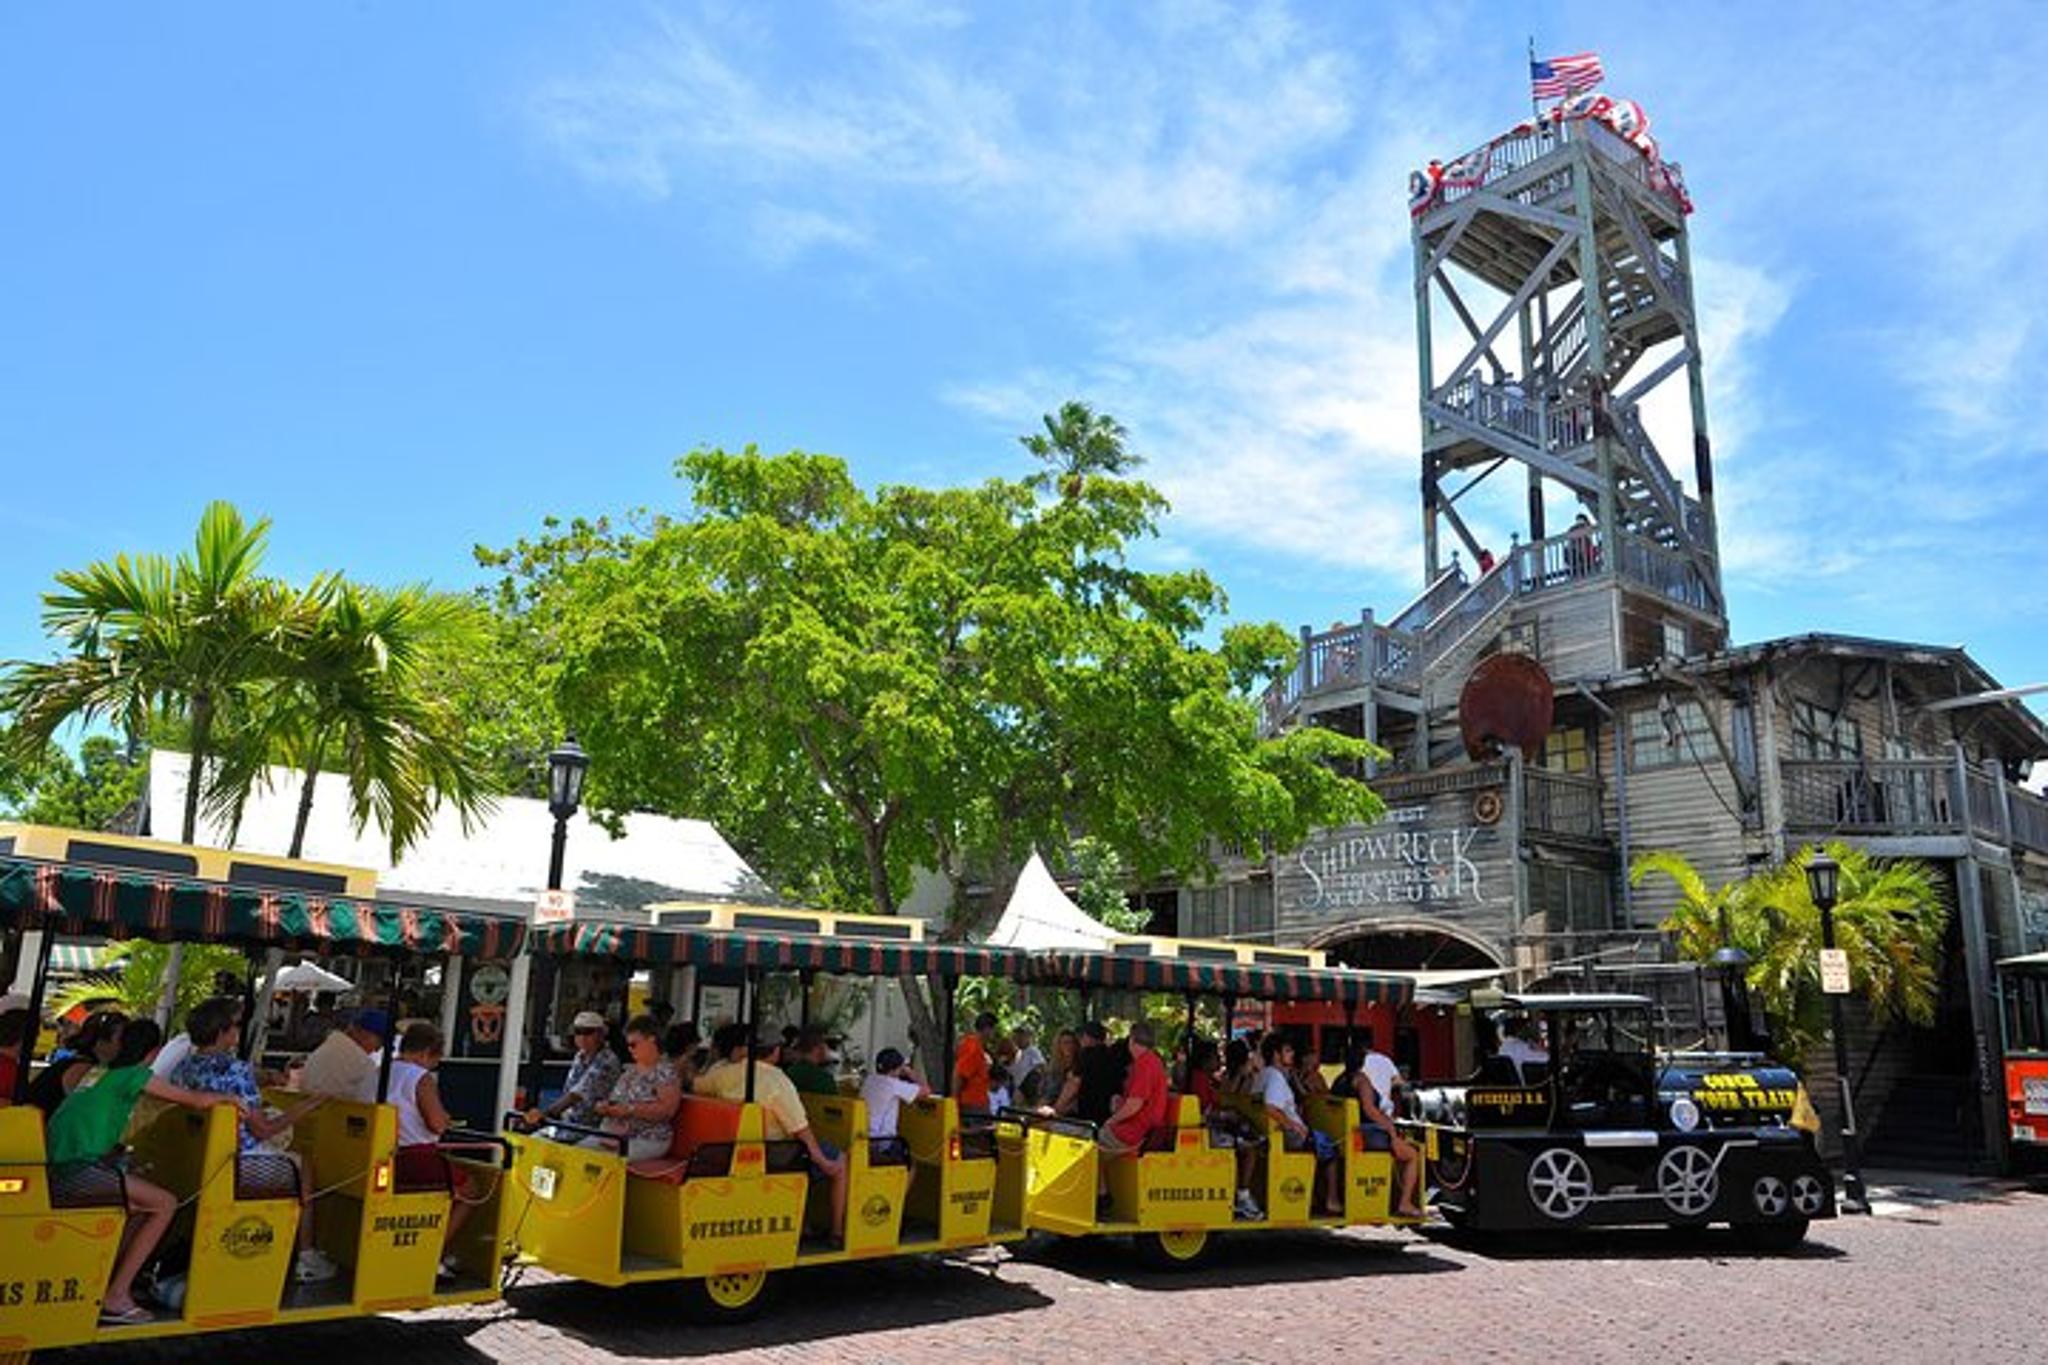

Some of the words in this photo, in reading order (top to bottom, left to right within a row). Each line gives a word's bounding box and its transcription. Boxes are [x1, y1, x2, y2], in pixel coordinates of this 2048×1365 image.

[1300, 827, 1483, 908] SHIPWRECK
[1324, 880, 1449, 908] MUSEUM
[1148, 1187, 1204, 1202] OVERSEAS
[392, 1231, 419, 1246] KEY
[689, 1217, 763, 1239] OVERSEAS
[34, 1277, 84, 1304] R.R.
